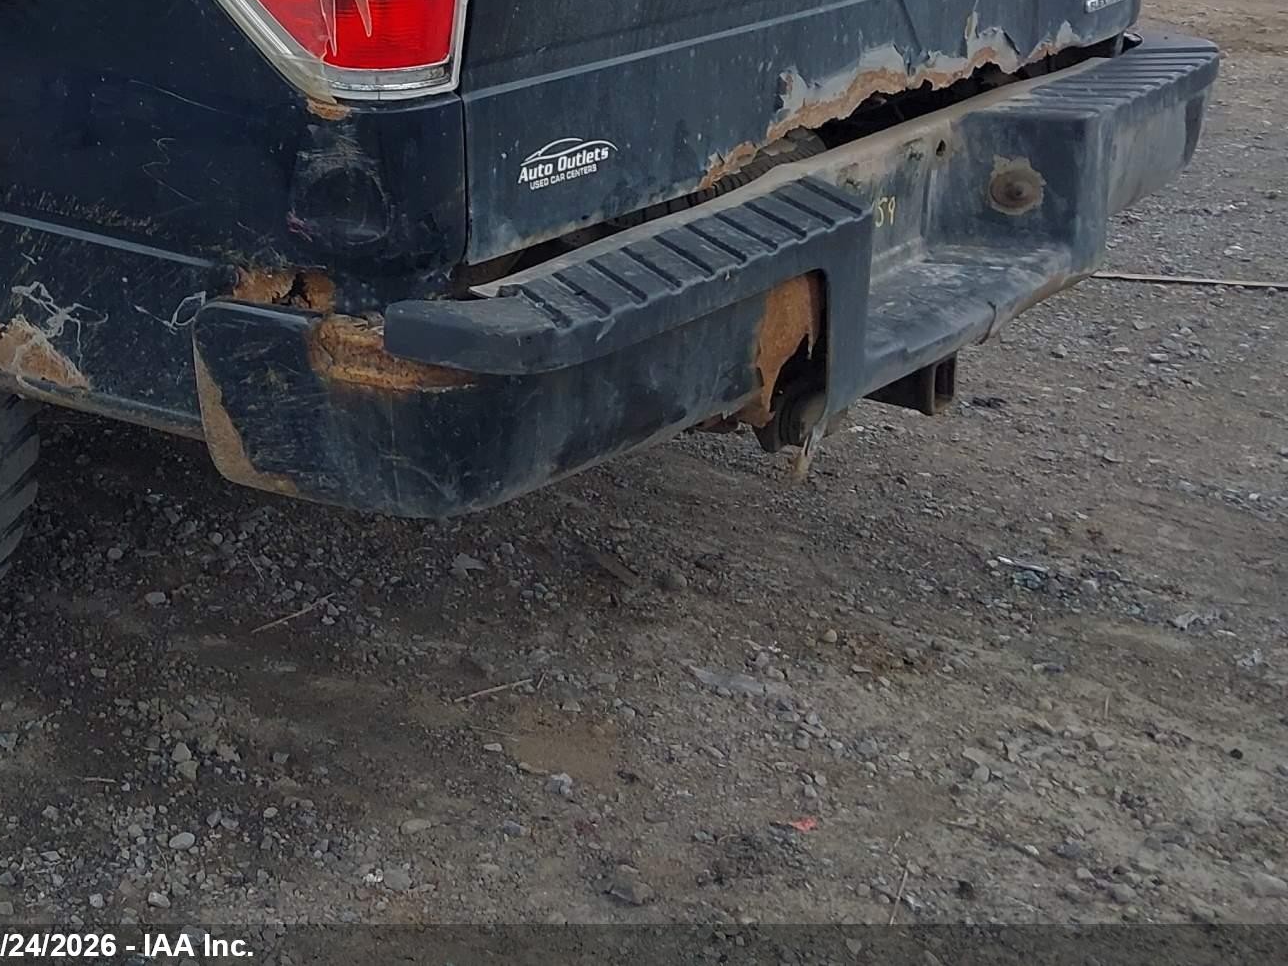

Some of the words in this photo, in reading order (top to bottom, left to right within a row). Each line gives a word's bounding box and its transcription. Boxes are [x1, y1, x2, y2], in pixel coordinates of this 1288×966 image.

[518, 163, 553, 184] Auto
[557, 147, 609, 172] Outlets
[529, 177, 549, 190] USED
[550, 172, 566, 184] CAR
[566, 163, 597, 179] CENTERS
